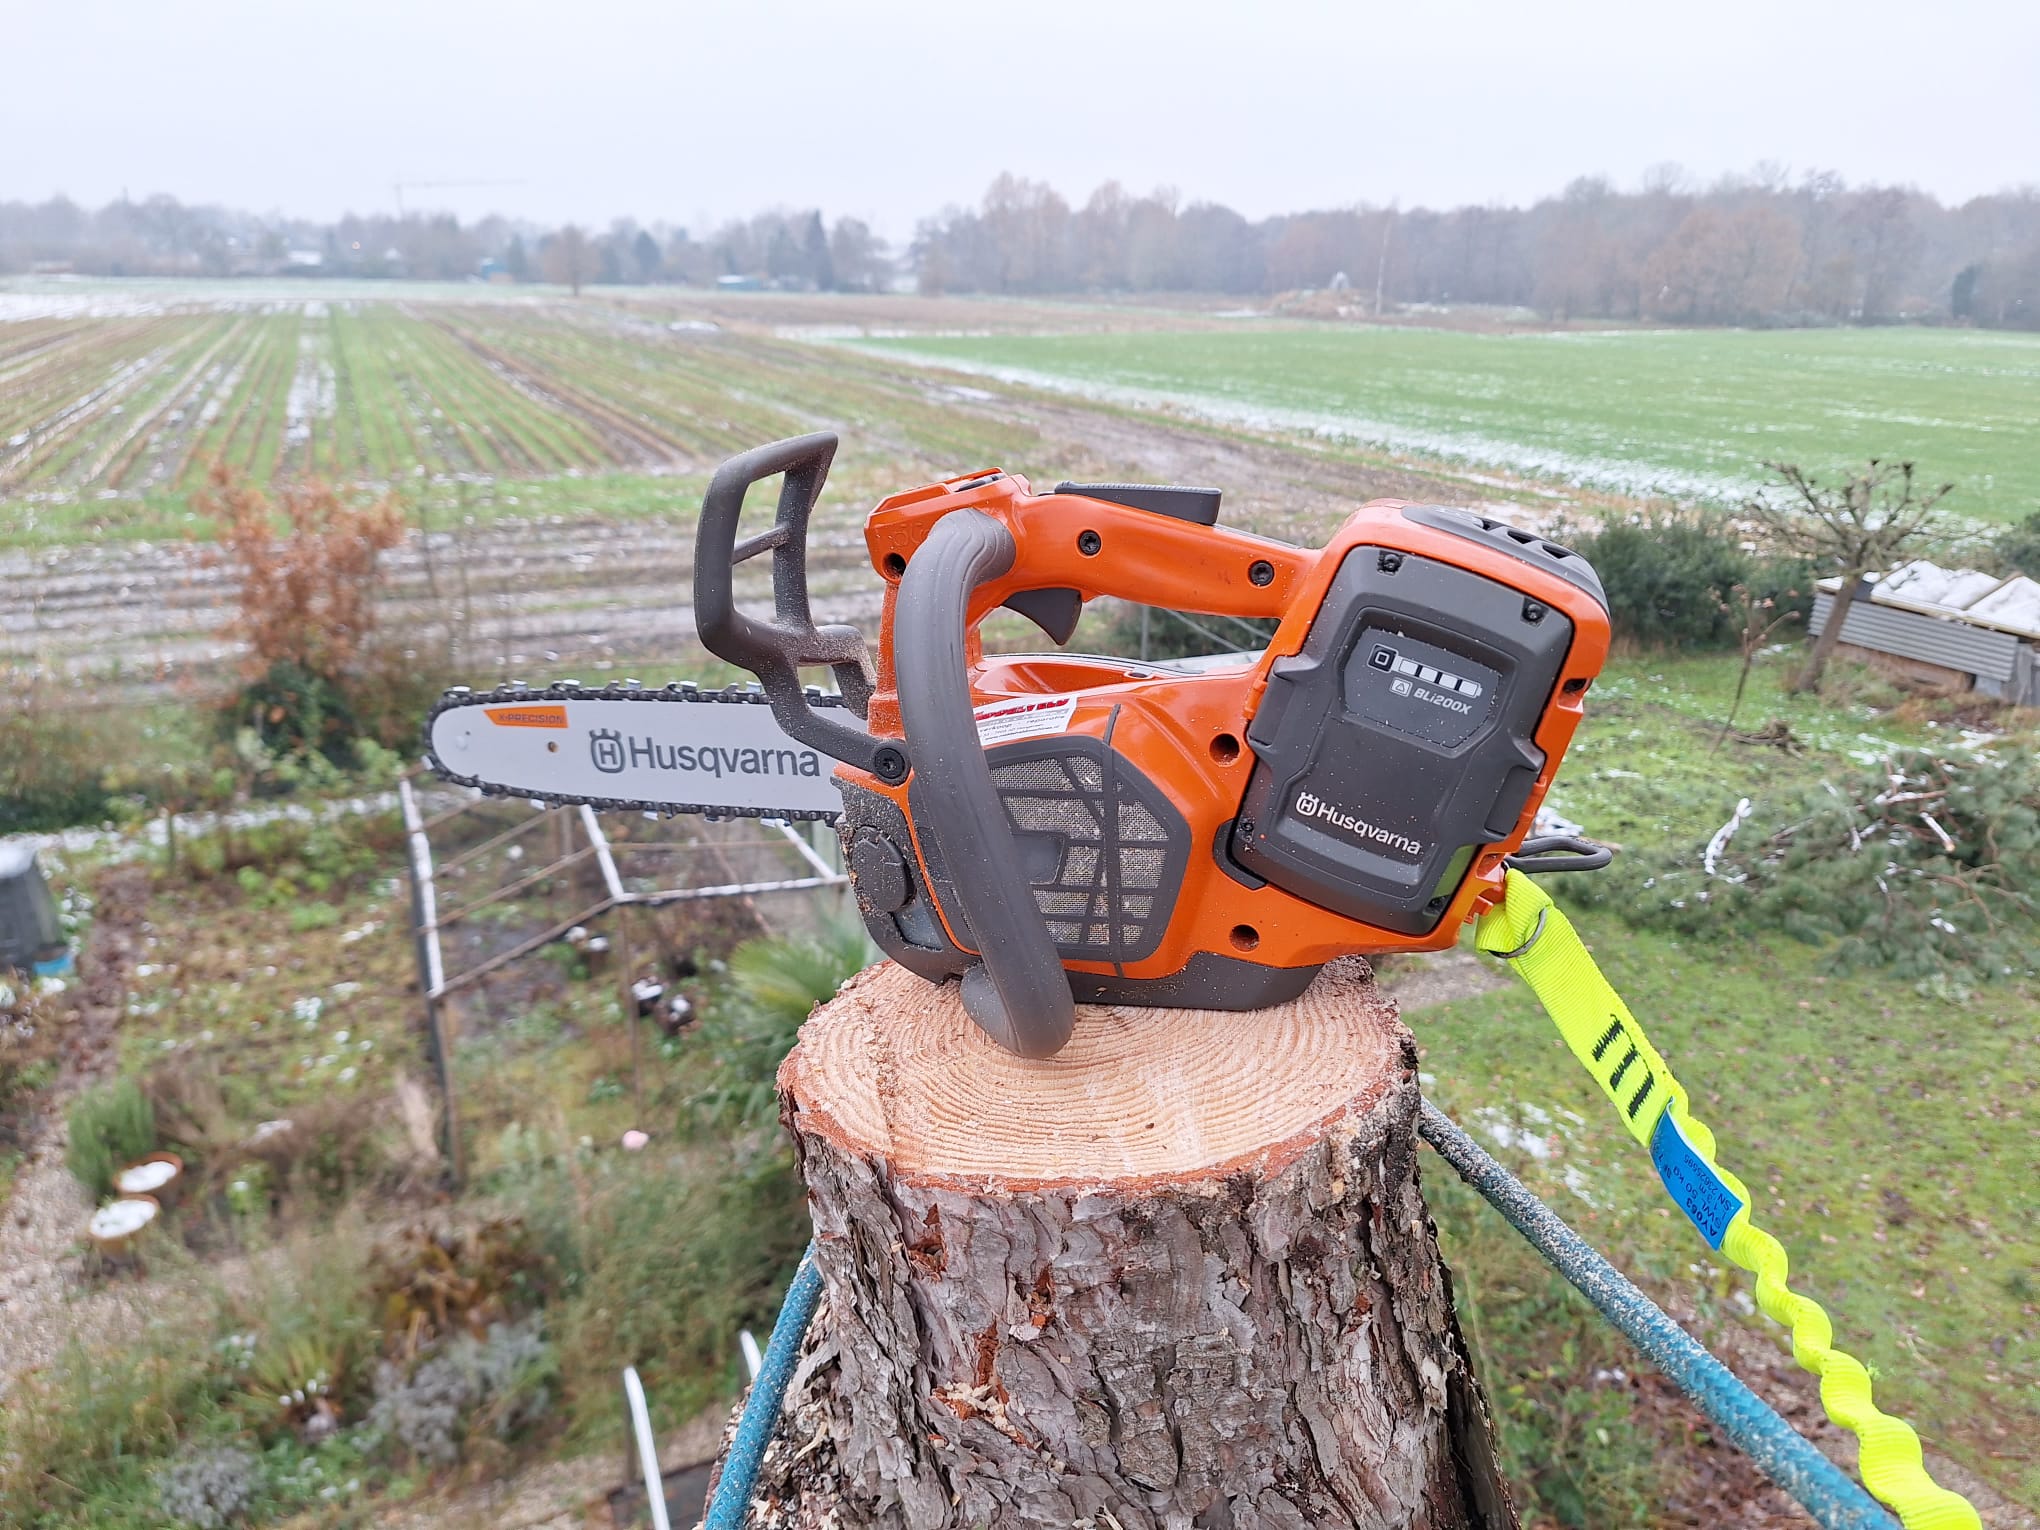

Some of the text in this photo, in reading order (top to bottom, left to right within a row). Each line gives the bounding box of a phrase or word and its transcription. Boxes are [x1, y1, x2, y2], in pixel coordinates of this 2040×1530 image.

[1414, 688, 1472, 715] BLi200X
[629, 736, 821, 778] Husqvarna
[1317, 802, 1422, 855] Husqvarna
[1685, 1183, 1699, 1199] 50
[1686, 1197, 1718, 1237] AY063
